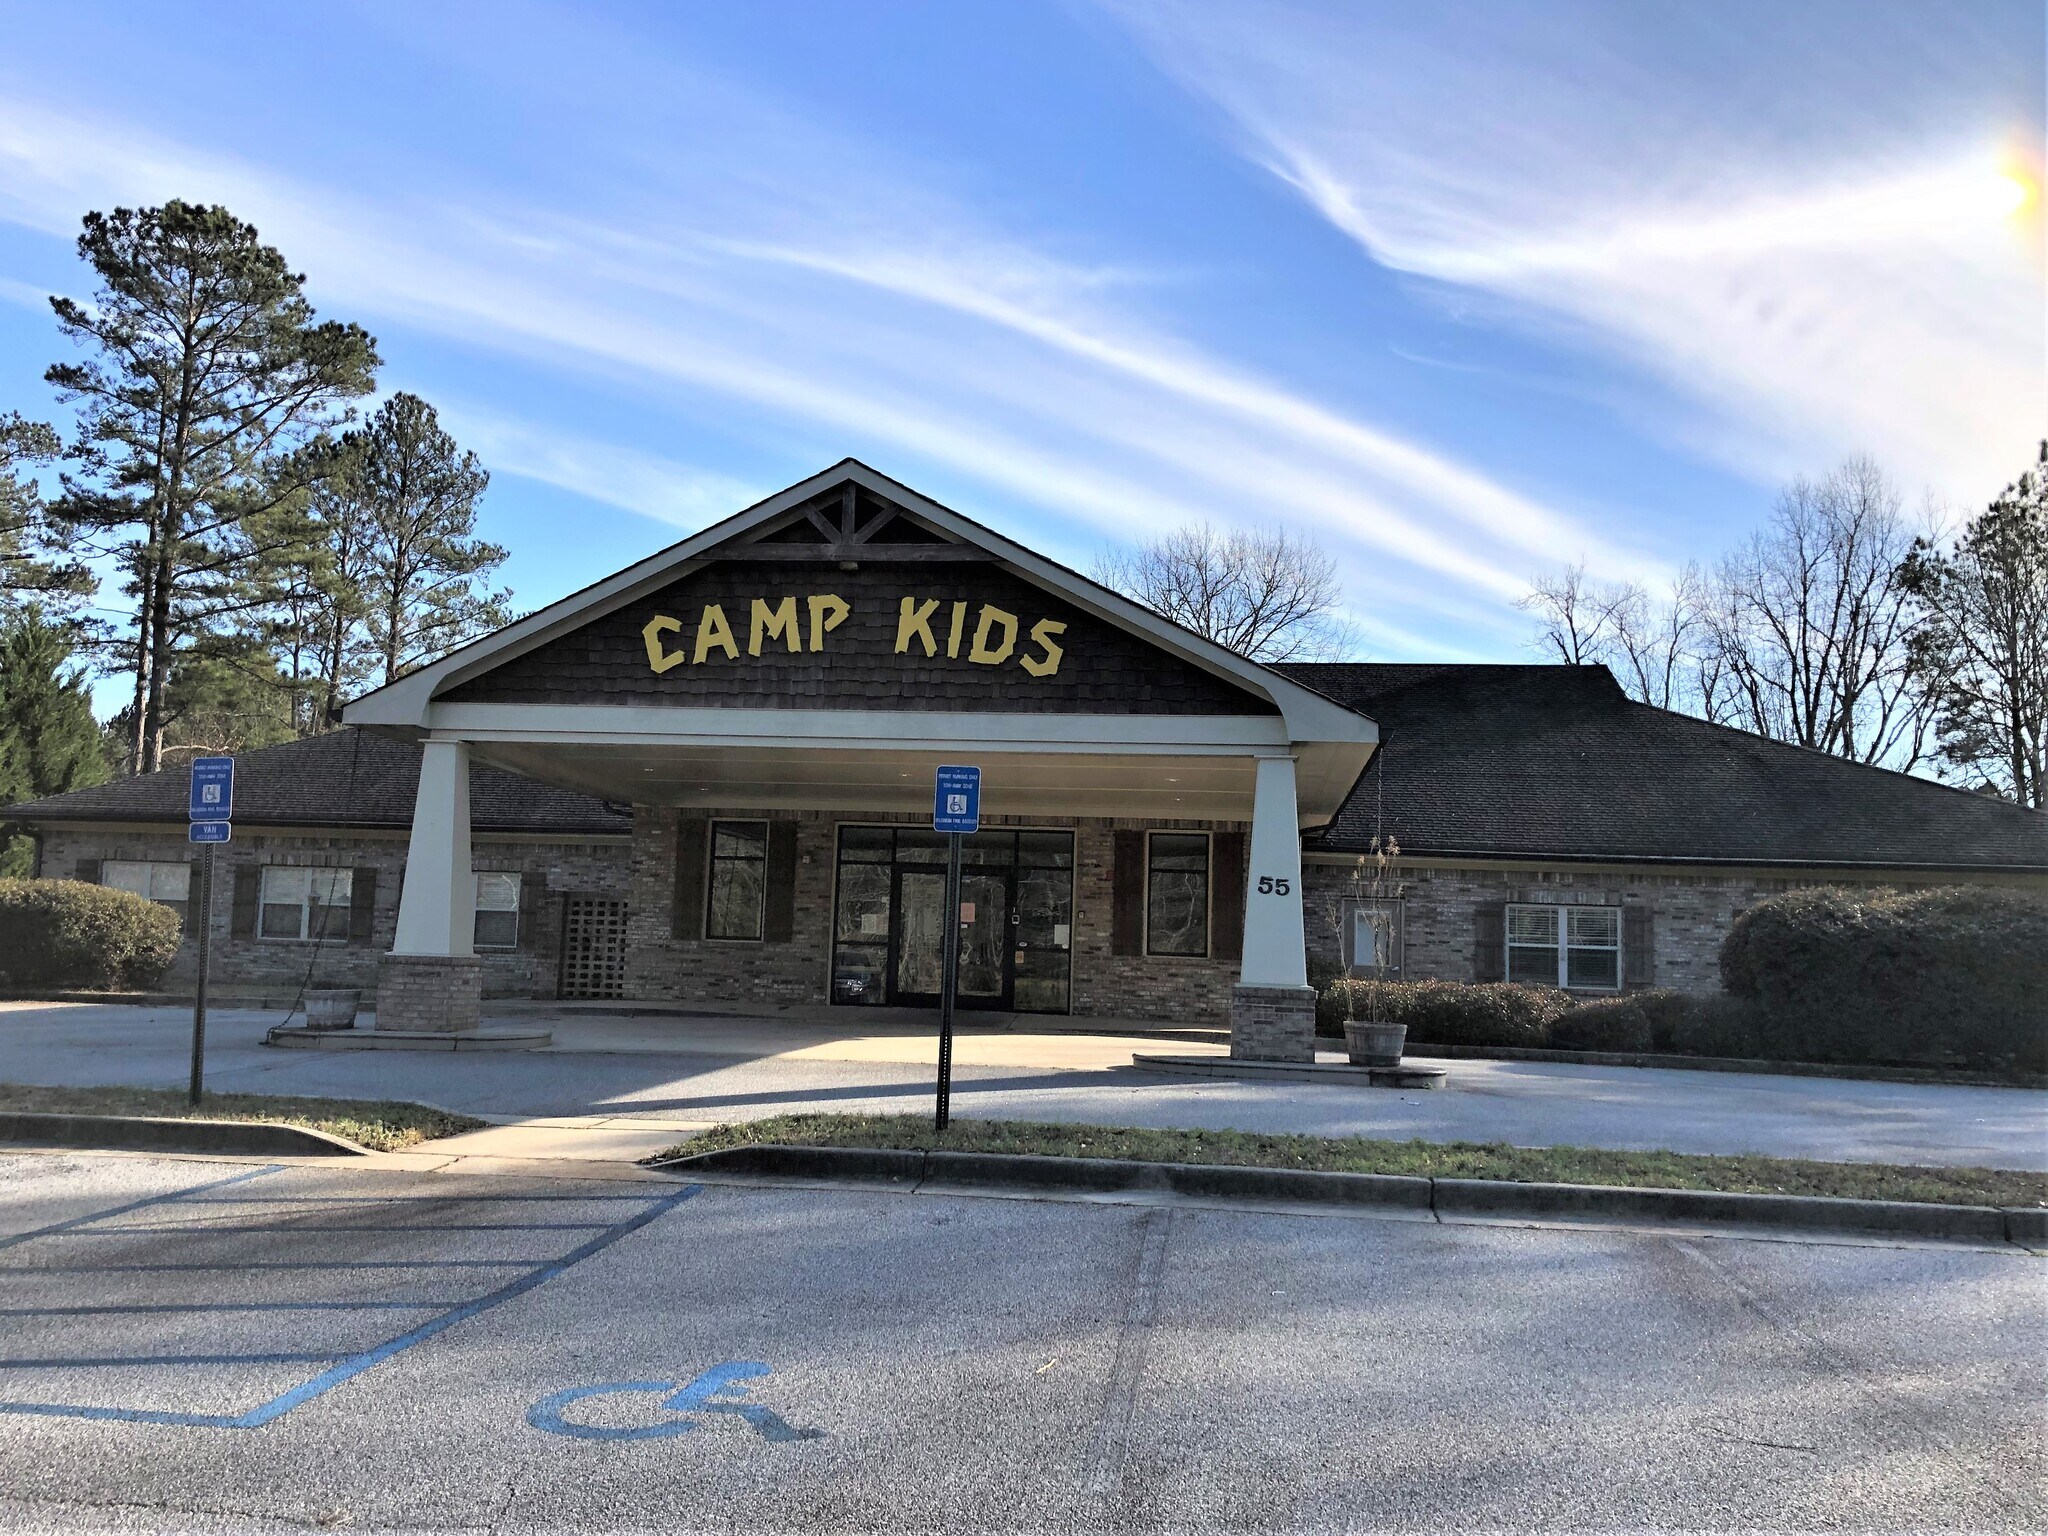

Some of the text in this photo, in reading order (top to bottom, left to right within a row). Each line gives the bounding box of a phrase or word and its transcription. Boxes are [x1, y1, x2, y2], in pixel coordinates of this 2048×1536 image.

[642, 594, 1068, 677] CAMP KIDS
[203, 825, 217, 833] VAN
[1258, 875, 1290, 896] 55
